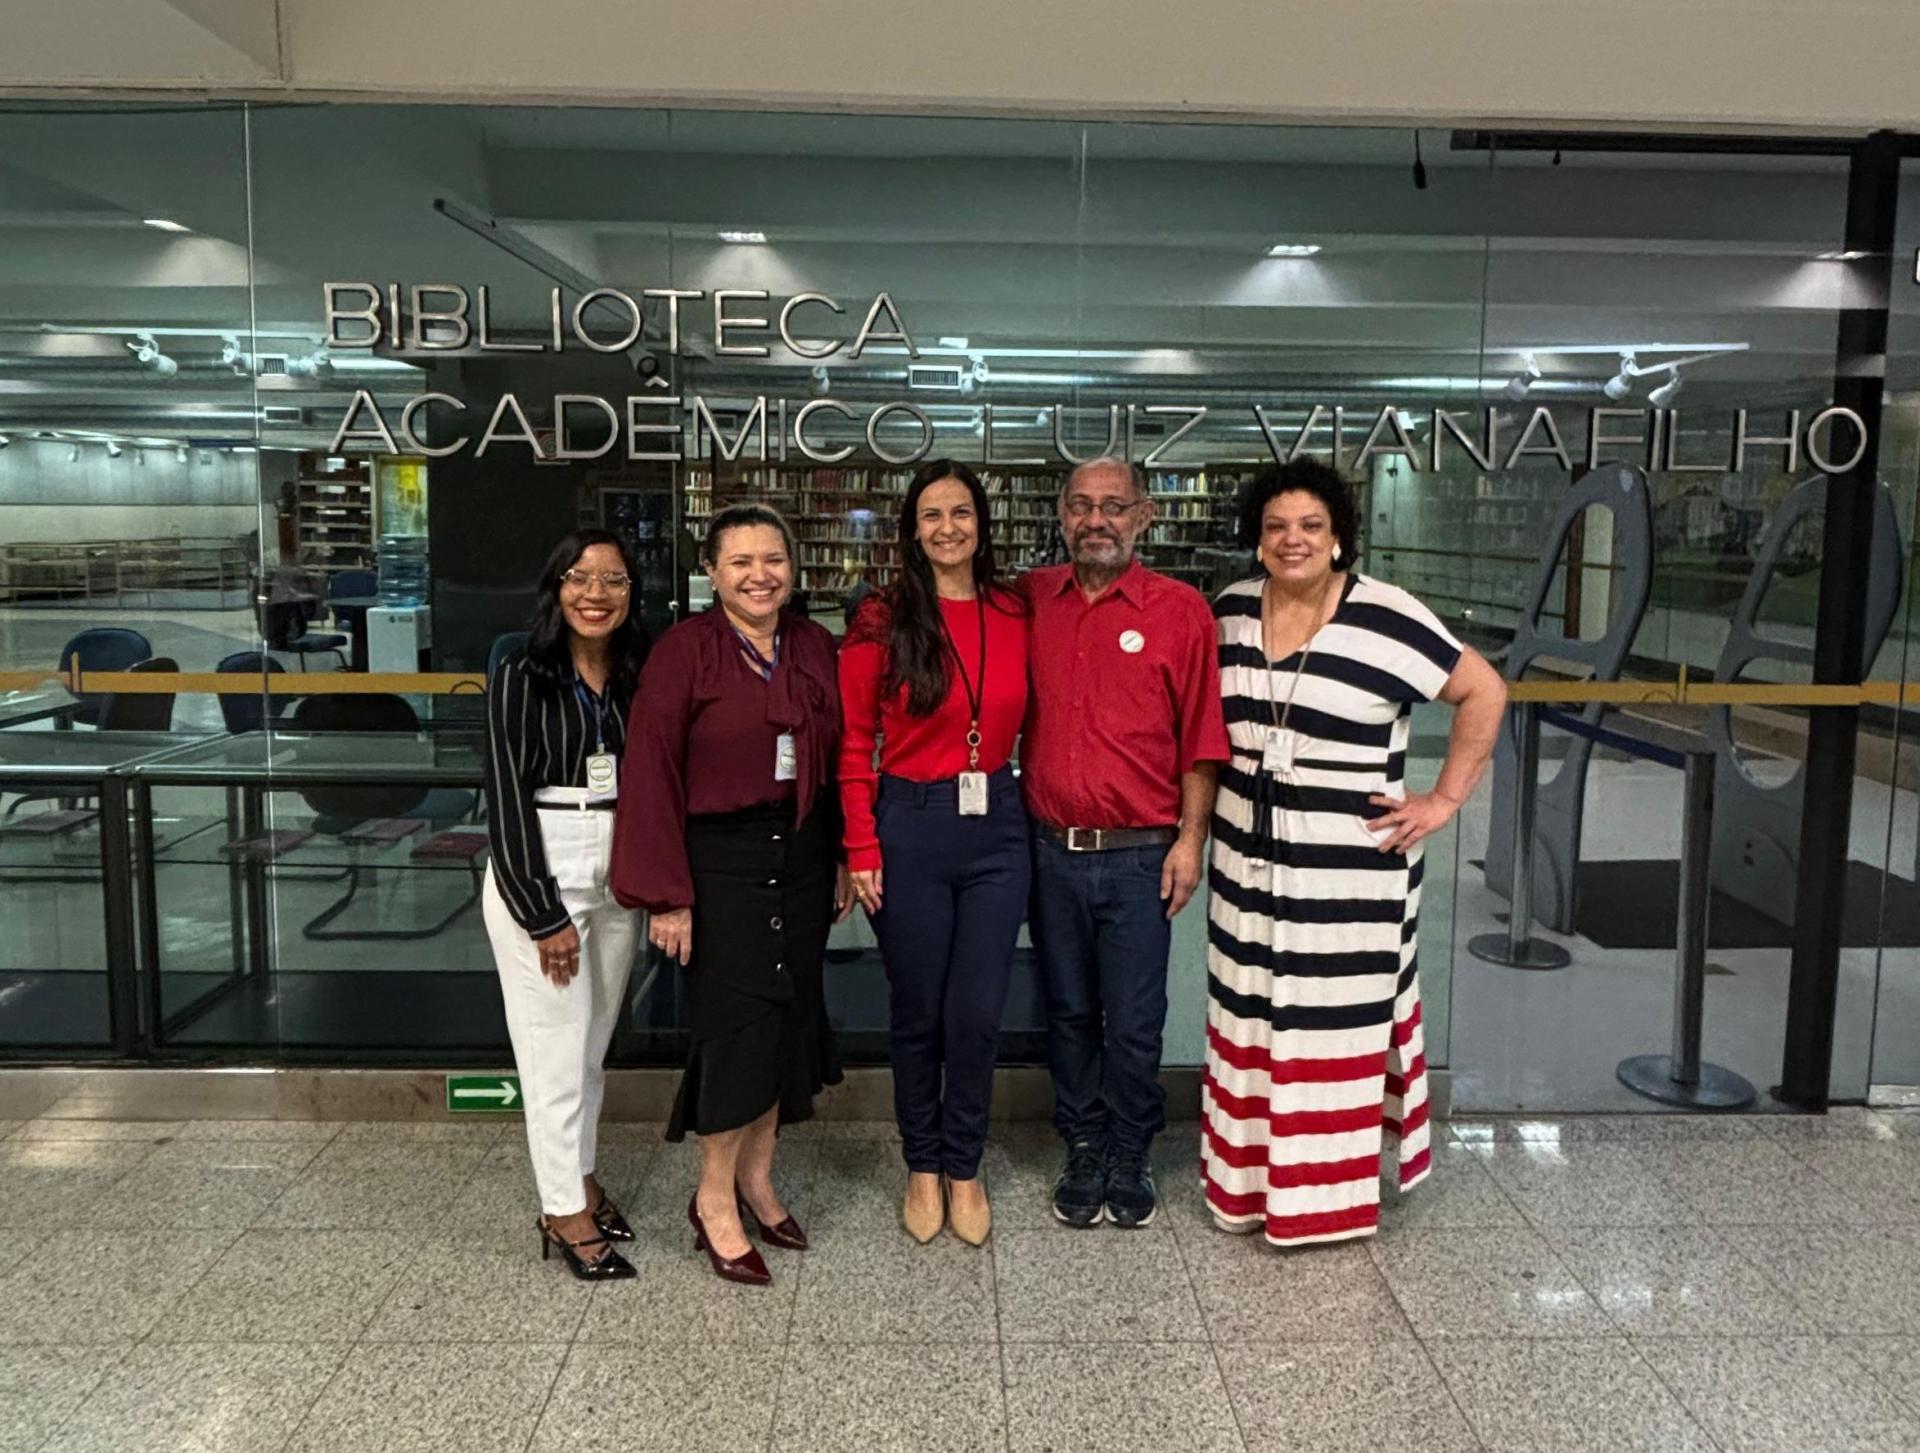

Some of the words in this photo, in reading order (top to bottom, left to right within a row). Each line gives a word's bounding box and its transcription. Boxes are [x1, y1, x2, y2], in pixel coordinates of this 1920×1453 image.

[322, 282, 919, 359] BIBLIOTECA
[328, 377, 934, 464] ACADÊMICO
[984, 403, 1207, 468] LUIZ
